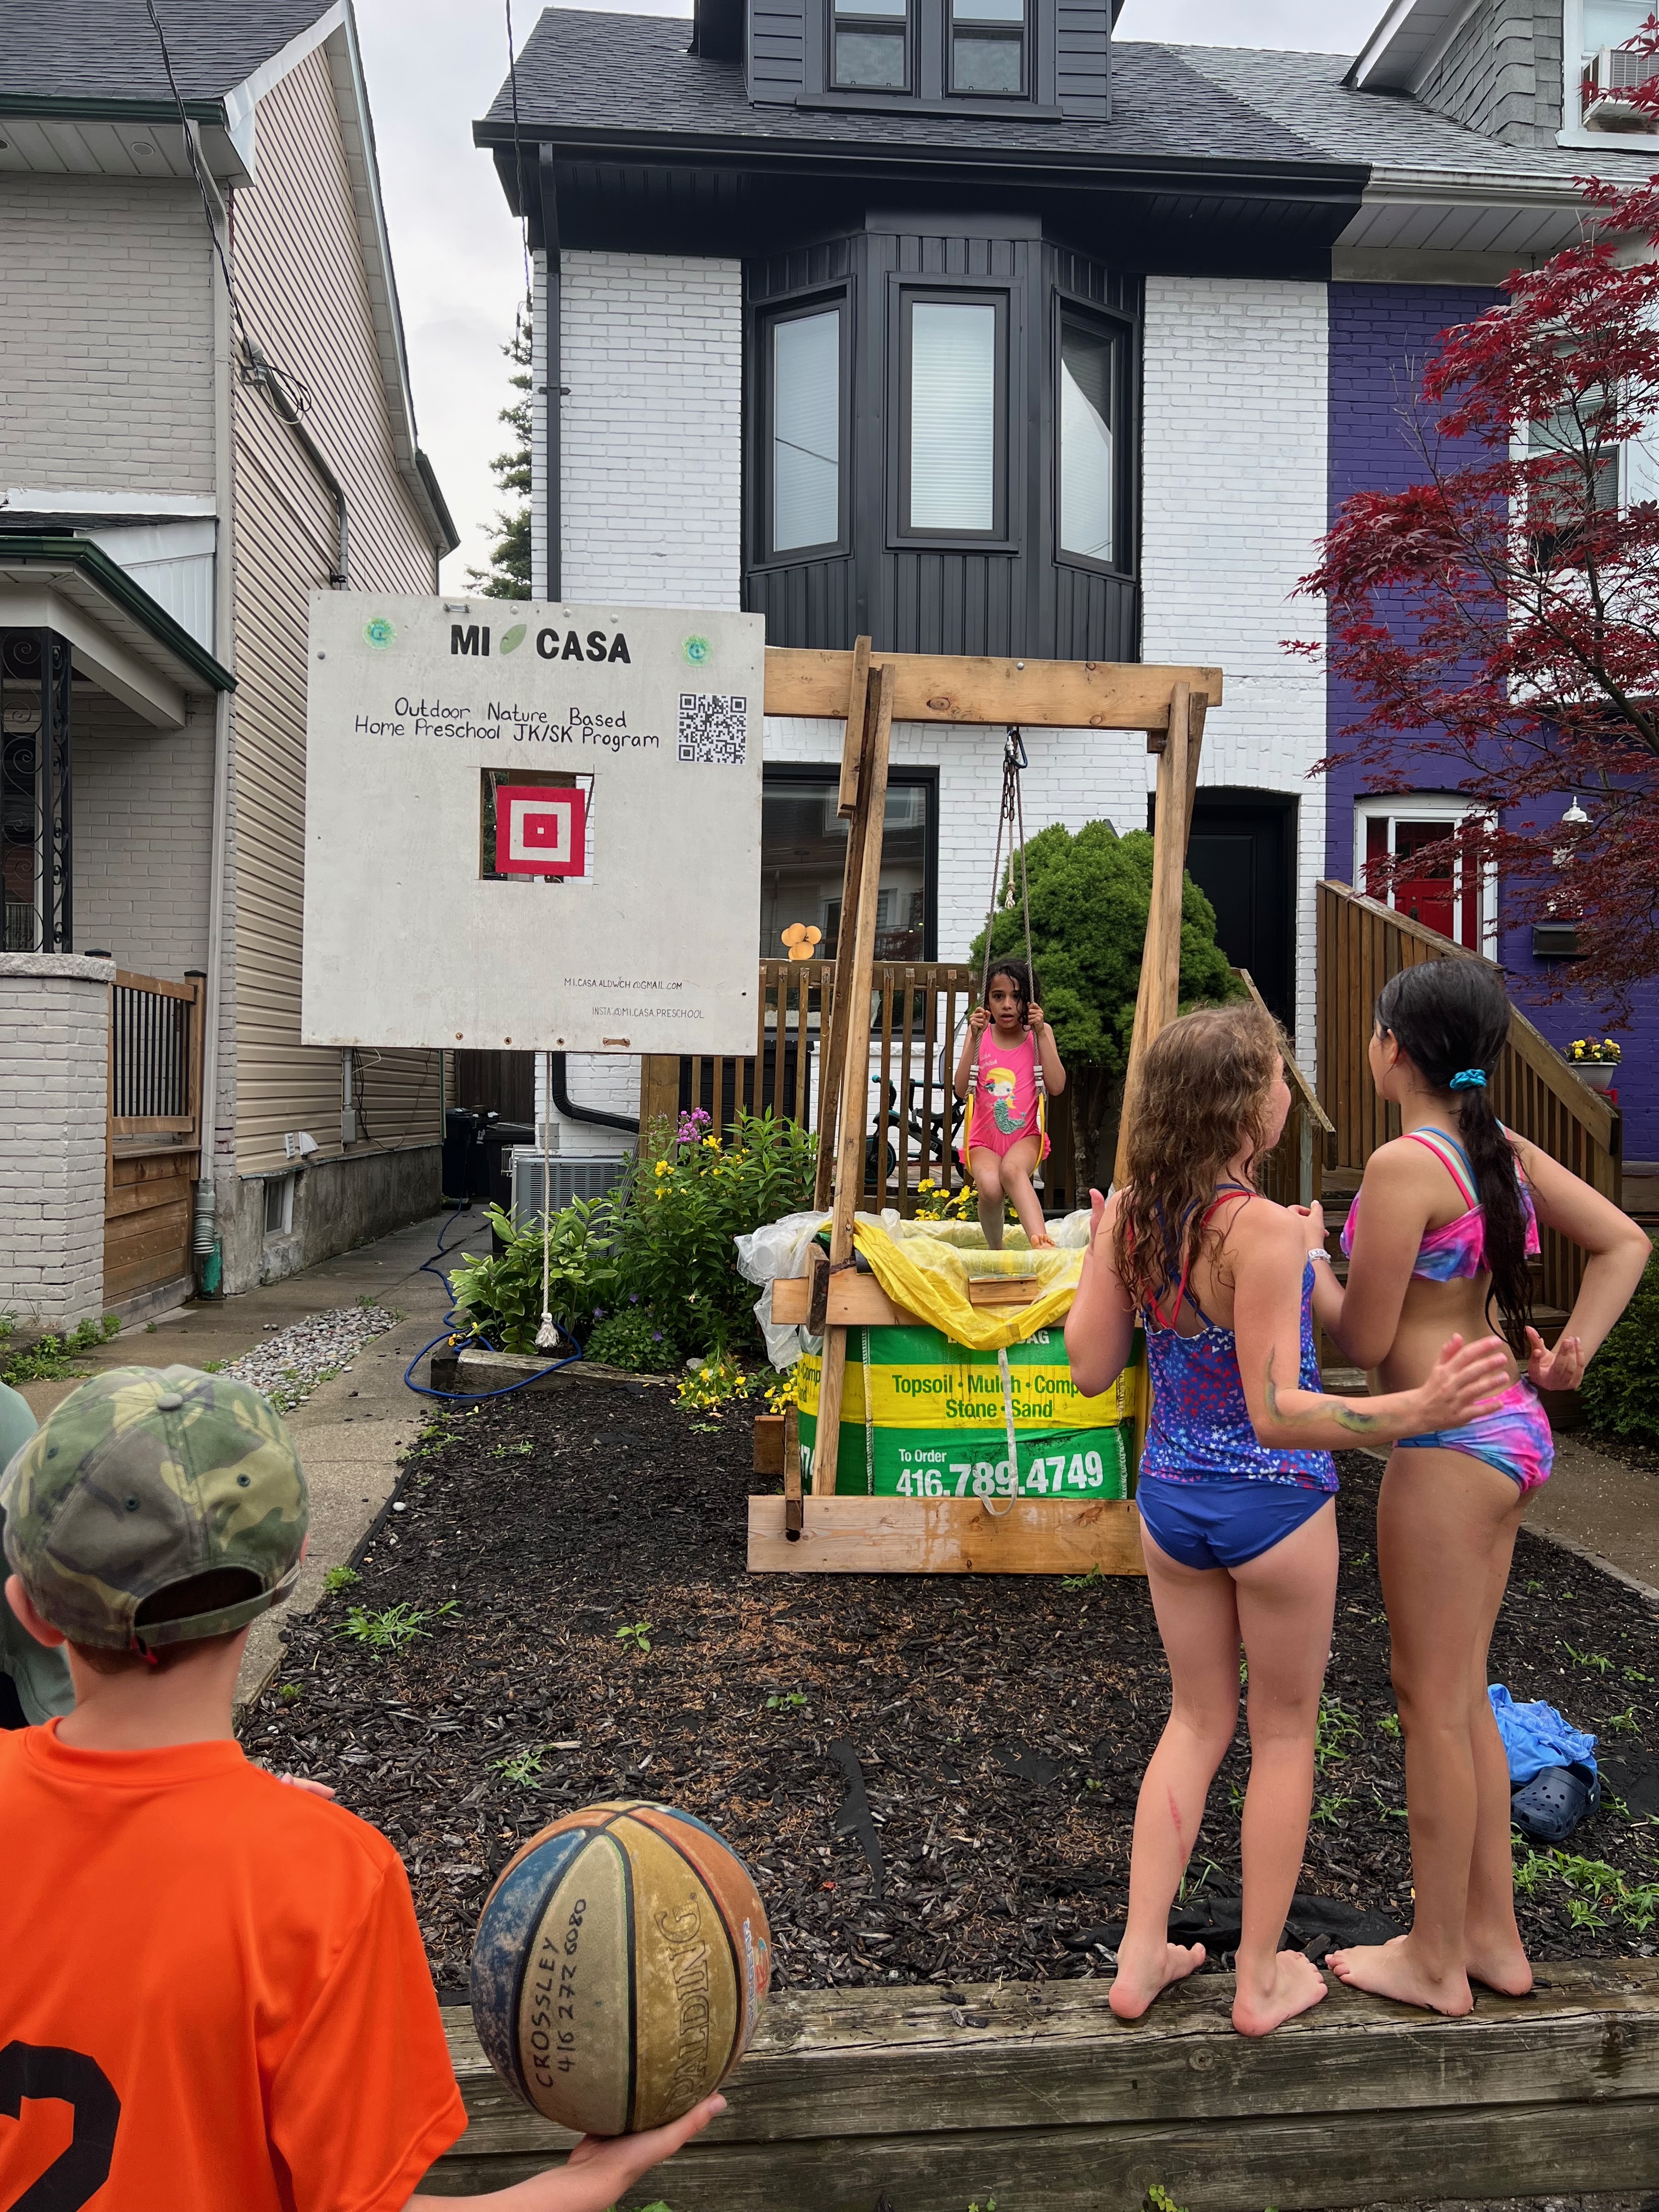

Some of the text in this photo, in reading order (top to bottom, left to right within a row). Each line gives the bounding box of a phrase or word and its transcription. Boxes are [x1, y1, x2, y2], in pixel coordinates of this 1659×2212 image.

[451, 624, 631, 664] MI CASA
[394, 697, 627, 728] Outdoor Nature Based
[356, 714, 659, 753] Home Preschool JK/SK Program
[891, 1375, 953, 1397] Topsoil
[967, 1374, 1021, 1393] Mulh
[945, 1398, 1053, 1419] Stone Sand
[898, 1448, 947, 1463] To Order
[565, 1898, 586, 1955] 6080
[531, 1937, 559, 2088] CROSSLEY
[557, 2030, 576, 2072] 416
